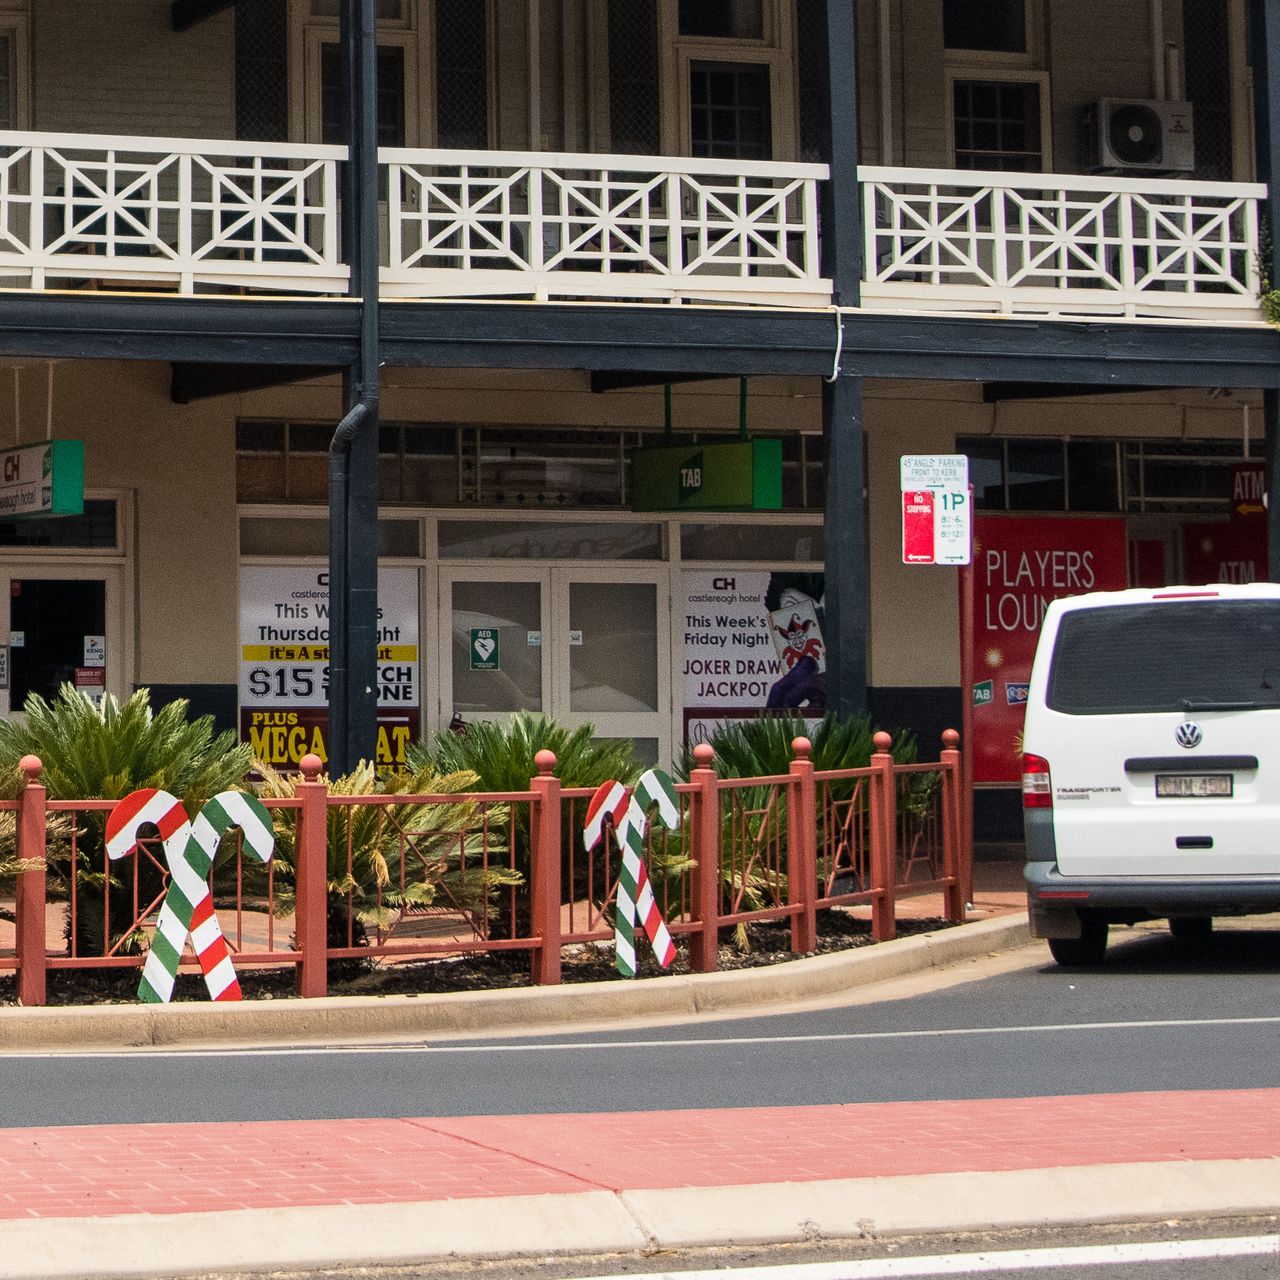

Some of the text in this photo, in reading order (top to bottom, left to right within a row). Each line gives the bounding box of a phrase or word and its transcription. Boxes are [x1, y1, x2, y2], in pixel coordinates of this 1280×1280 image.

[680, 468, 702, 488] TAB
[1233, 471, 1265, 499] ATM
[913, 494, 924, 503] NO
[942, 492, 965, 510] 1P
[906, 505, 931, 514] STOPPING
[986, 550, 1095, 588] PLAYERS
[1218, 560, 1255, 583] ATM
[712, 577, 736, 590] CH
[688, 594, 760, 604] castlereagh hotel
[275, 603, 308, 619] This
[685, 615, 767, 628] This Week's
[258, 625, 330, 641] Thursda
[477, 630, 491, 638] AED
[684, 632, 769, 648] Friday Night
[269, 646, 294, 660] it's
[298, 646, 309, 660] A
[682, 659, 781, 675] JOKER DRAW
[248, 667, 314, 698] $15
[697, 681, 769, 697] JACKPOT
[973, 689, 991, 700] AB
[251, 712, 298, 725] PLUS
[249, 726, 329, 763] MEGA
